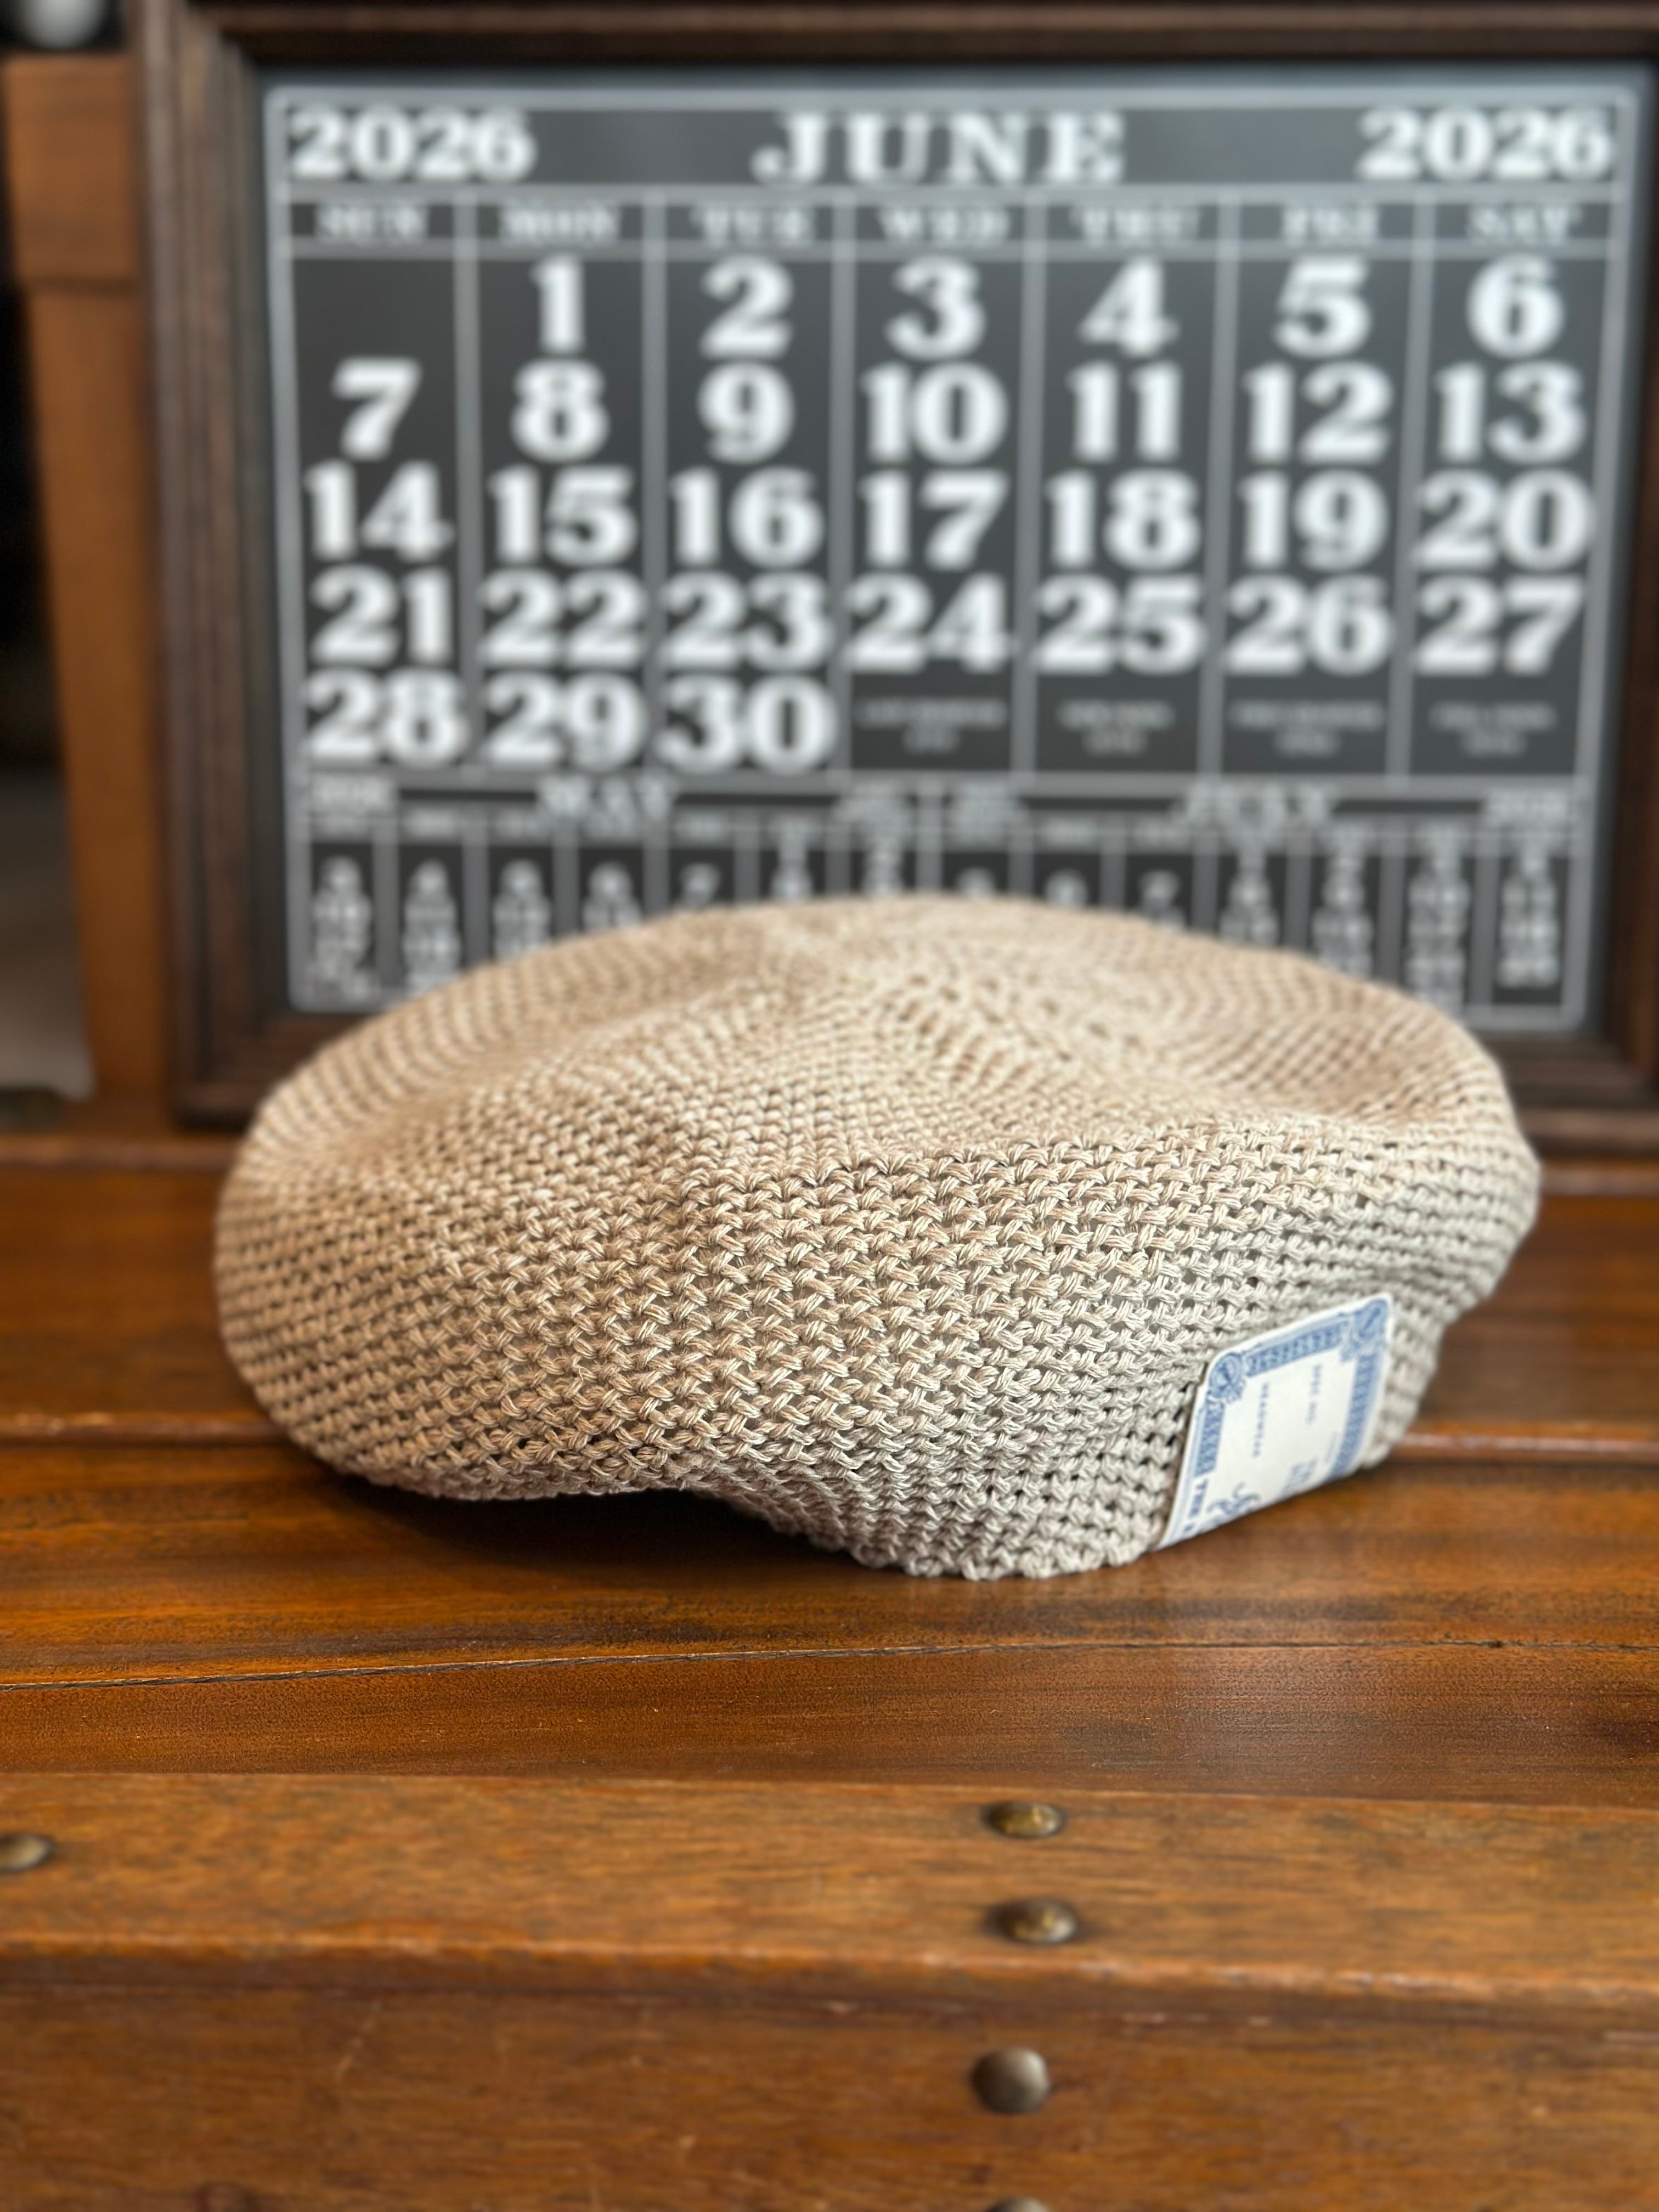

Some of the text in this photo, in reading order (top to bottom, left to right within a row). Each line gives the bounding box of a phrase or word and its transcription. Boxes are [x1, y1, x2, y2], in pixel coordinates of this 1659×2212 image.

[290, 107, 1614, 185] 2026 JUNE 2026
[531, 253, 1565, 360] 1 2 3 4 5 6
[331, 356, 1586, 465] 7 8 9 10 11 12 13
[304, 459, 1595, 572] 14 15 16 17 18 19 20
[309, 565, 1586, 676] 21 22 23 24 25 26 27
[301, 667, 838, 774] 28 29 30
